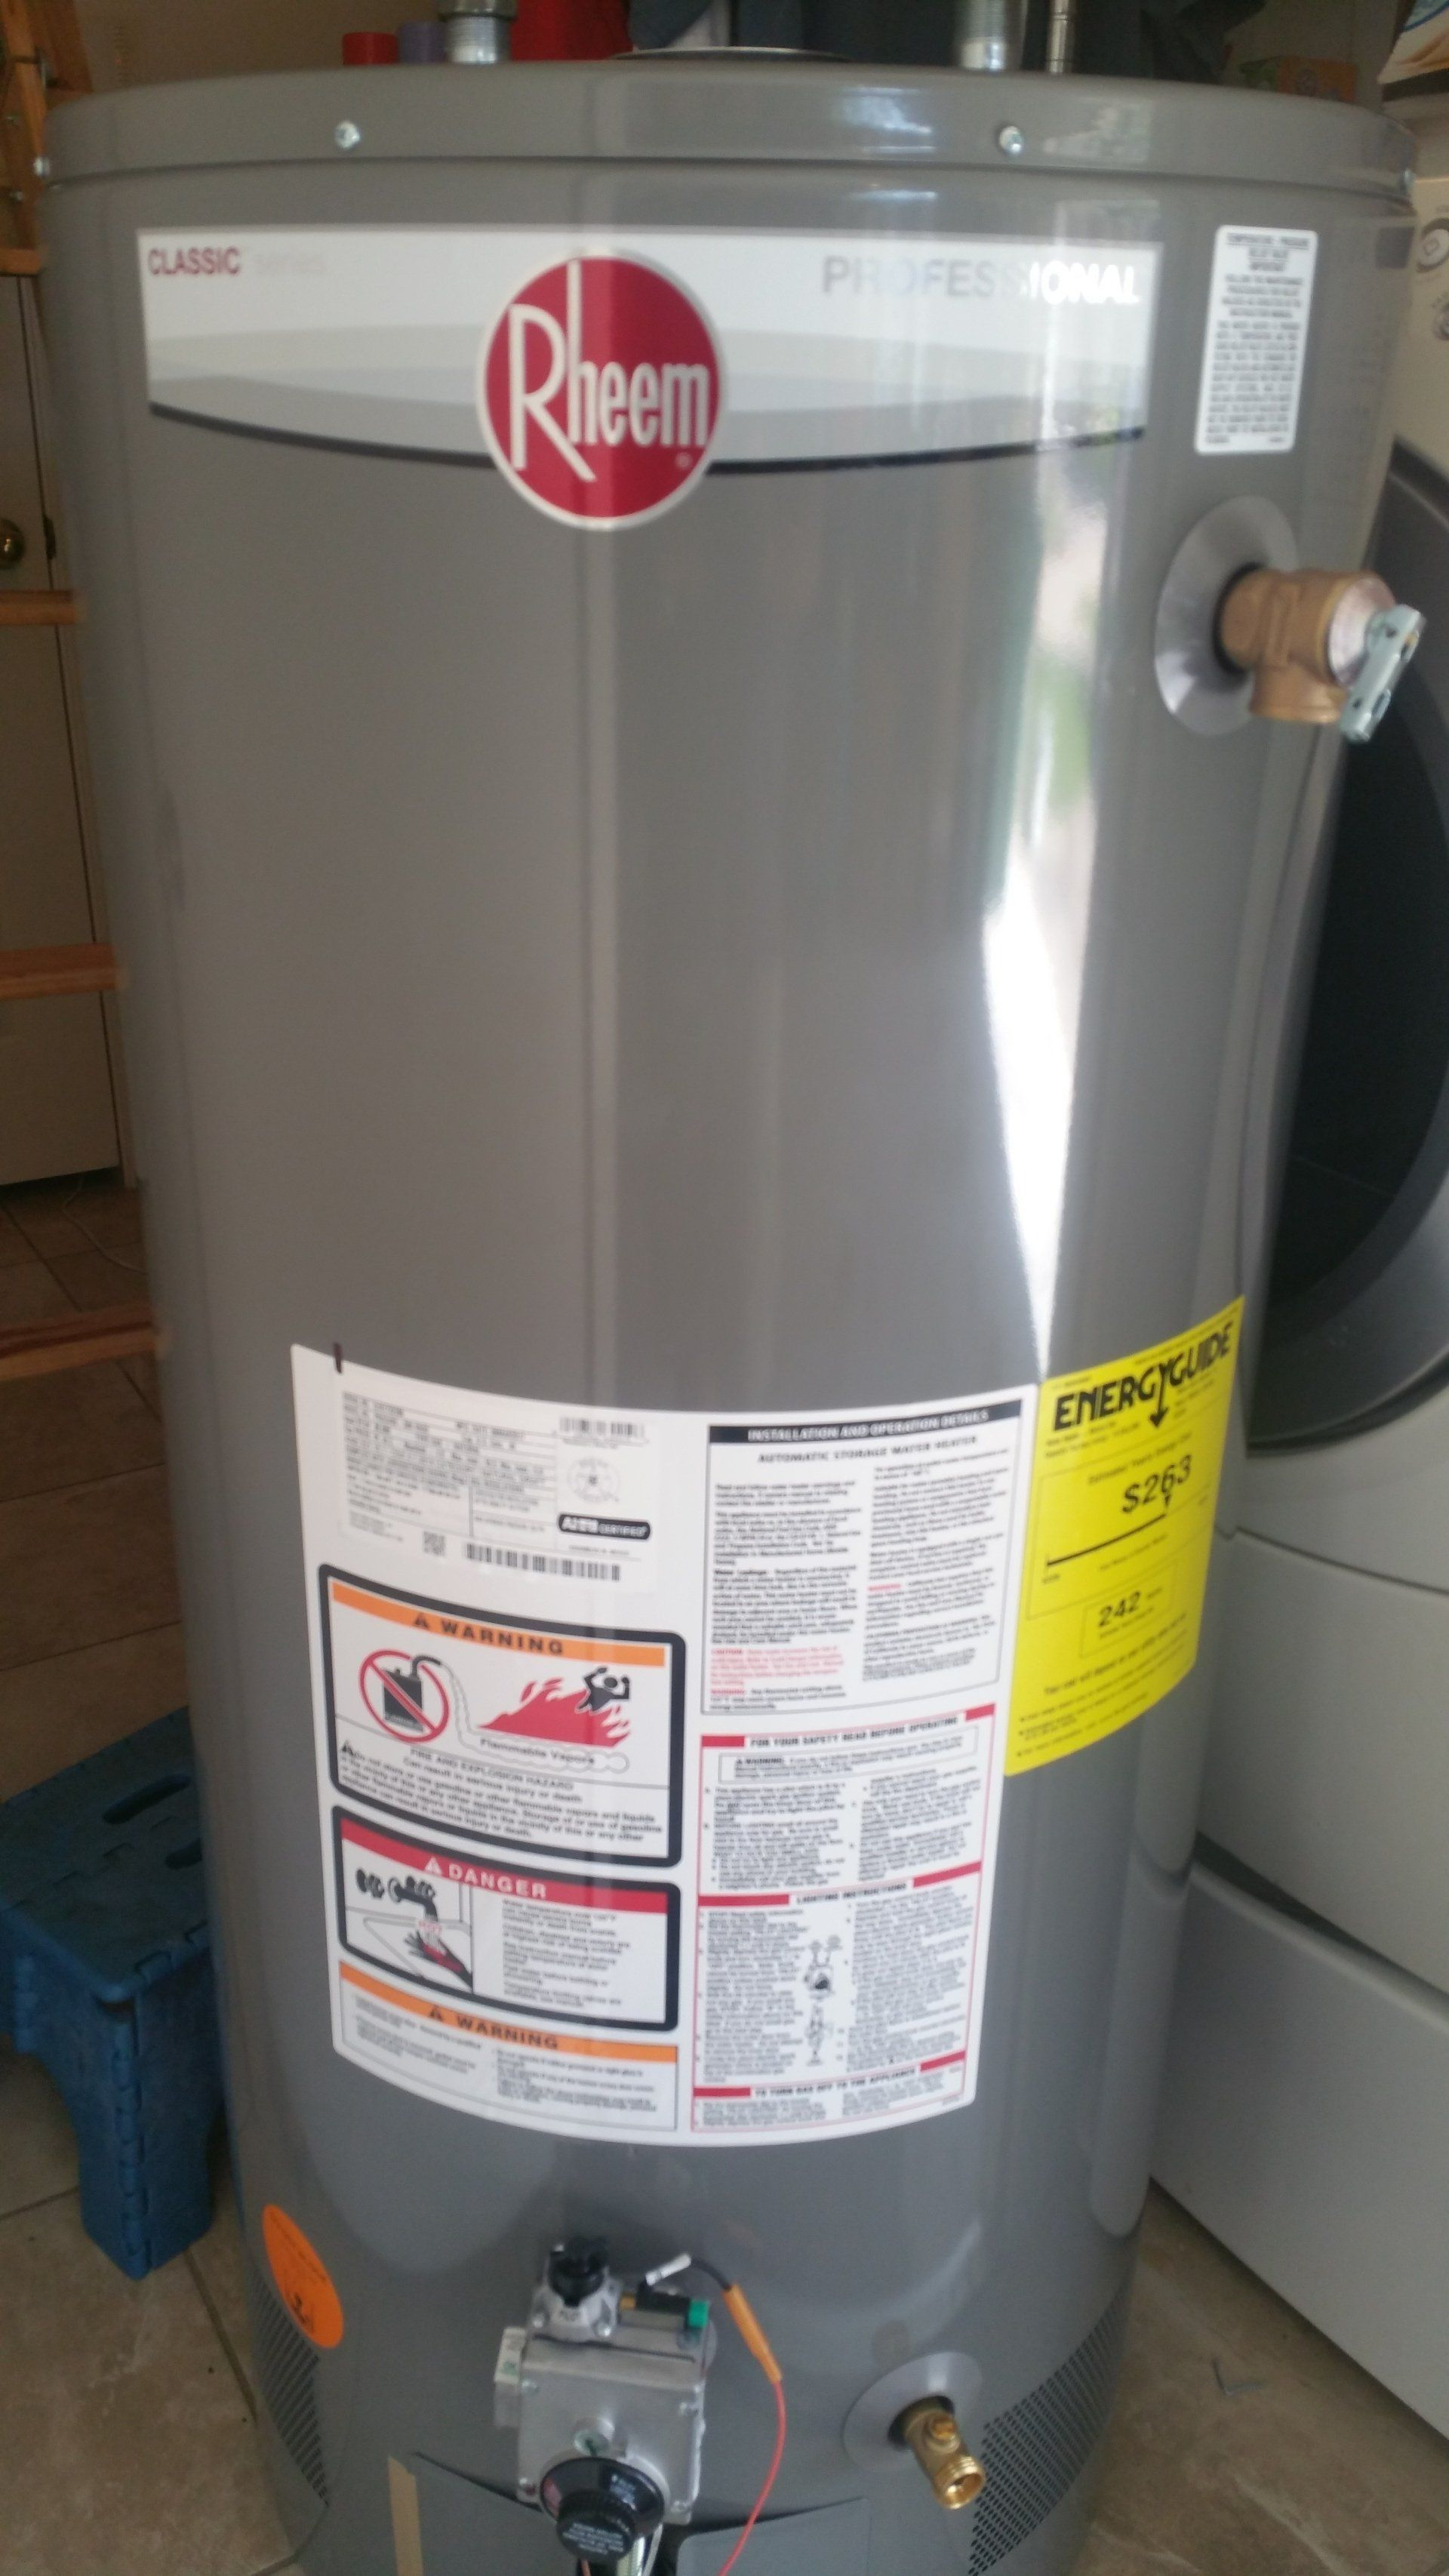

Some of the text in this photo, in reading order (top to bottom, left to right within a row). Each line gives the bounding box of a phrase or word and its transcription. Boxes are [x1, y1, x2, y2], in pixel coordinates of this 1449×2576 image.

[147, 245, 241, 275] CLASSIC
[823, 255, 1140, 304] PROFESSIONAL
[508, 259, 712, 483] Rheem
[747, 1411, 989, 1443] INSTALLATION AND OPERATION DETAILS
[757, 1435, 979, 1463] AUTOMATIC STORAGE WATER HEATER
[1098, 1590, 1142, 1628] 242
[441, 1618, 564, 1656] WARNING
[479, 1737, 595, 1765] Flammable Vapors
[802, 1734, 840, 1746] SAFETY
[410, 1747, 574, 1791] FIRE AND EXPLOSION HAZARD
[423, 1765, 451, 1777] result
[506, 1782, 534, 1797] injury
[435, 1780, 472, 1795] gasoline
[486, 1792, 510, 1805] other
[512, 1795, 562, 1813] flammable
[602, 1811, 620, 1821] and
[448, 1862, 547, 1900] DANGER
[456, 2013, 558, 2051] WARNING
